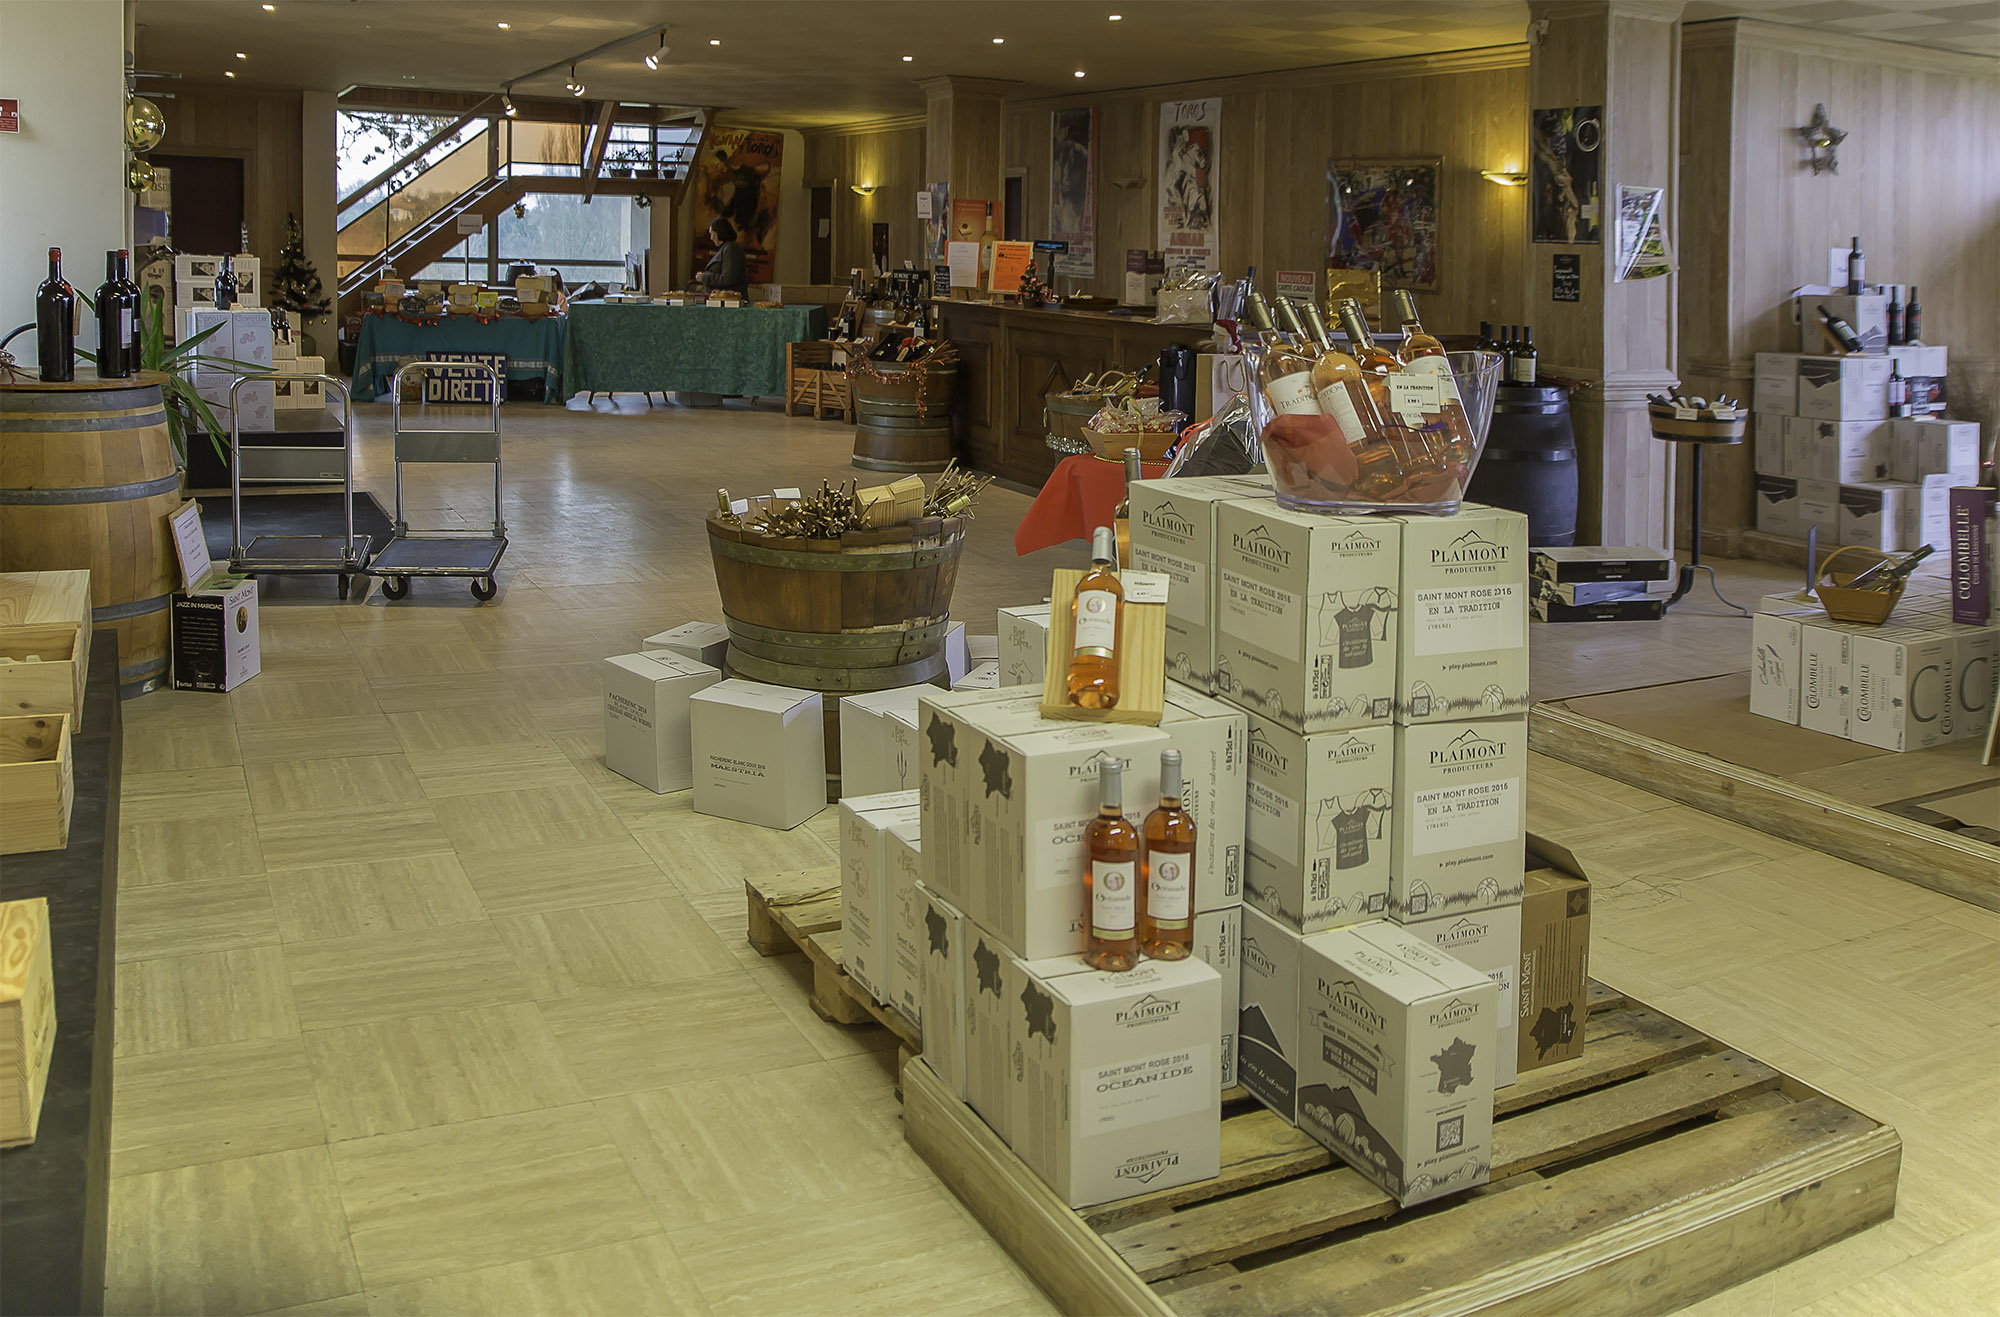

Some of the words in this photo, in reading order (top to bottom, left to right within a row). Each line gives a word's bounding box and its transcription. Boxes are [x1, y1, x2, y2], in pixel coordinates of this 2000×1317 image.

[1174, 101, 1206, 122] TOROS
[235, 315, 267, 323] Corolle
[430, 354, 506, 378] VENTE
[1143, 511, 1195, 537] PLAIMONT
[1151, 530, 1186, 545] PRODUCTEURS
[1331, 540, 1382, 551] PLAIMONT
[1135, 548, 1150, 558] SAINT
[1151, 552, 1167, 564] MONT
[1168, 556, 1183, 568] ROSE
[1233, 534, 1291, 565] PLAIMONT
[1431, 546, 1509, 563] PLAIMONT
[1957, 506, 1971, 600] COLOMBELLE
[1141, 563, 1148, 571] EN
[1150, 565, 1158, 574] LA
[1241, 556, 1280, 574] PRODUCTEURS
[1444, 565, 1496, 575] PRODUCTEURS
[1223, 573, 1240, 586] SAINT
[1241, 578, 1258, 591] MONT
[1259, 584, 1275, 598] ROSE
[1417, 592, 1443, 602] SAINT
[1444, 590, 1468, 600] MONT
[1470, 588, 1492, 598] ROSE
[1230, 588, 1237, 598] EN
[1240, 592, 1248, 602] LA
[1250, 597, 1283, 615] TRADITION
[1428, 607, 1440, 616] EN
[1444, 606, 1455, 615] LA
[1458, 602, 1501, 613] TRADITION
[1807, 652, 1821, 709] COLOMBELLE
[1857, 664, 1872, 722] COLOMBELLE
[1910, 665, 1940, 723] C
[1942, 659, 1954, 735] COLOMBELLE
[709, 755, 733, 764] PACHERENC
[1328, 743, 1376, 760] PLAIMONT
[1429, 742, 1507, 764] PLAIMONT
[710, 763, 766, 778] MAESTRIA
[1069, 759, 1132, 776] PLAIT
[1442, 762, 1494, 775] PRODUCTEURS
[1256, 785, 1273, 801] ROSE
[1416, 793, 1441, 804] SAINT
[1442, 789, 1467, 800] MONT
[1468, 786, 1490, 796] ROSE
[1427, 806, 1438, 816] EN
[1442, 804, 1452, 814] LA
[1456, 797, 1500, 812] TRADITION
[1053, 821, 1077, 831] SAINT
[1436, 925, 1489, 943] PLAIMONT
[1445, 939, 1480, 949] PRODUCTEURS
[1241, 945, 1277, 975] AIMONT
[1521, 952, 1532, 988] MONT
[1115, 1000, 1181, 1023] PLAIMONT
[1318, 977, 1388, 1030] PLAIMONT
[1429, 1003, 1480, 1024] PLAIMONT
[1520, 990, 1532, 1018] SAINT
[1328, 1003, 1374, 1036] PRODUCTEURS
[1096, 1065, 1194, 1093] OCEANIDE
[1098, 1066, 1122, 1080] SAINT
[1123, 1062, 1147, 1075] MONT
[1148, 1057, 1171, 1069] ROSE
[1424, 1144, 1480, 1168] play.plaimont.com
[1114, 1155, 1180, 1179] PLAIMONT
